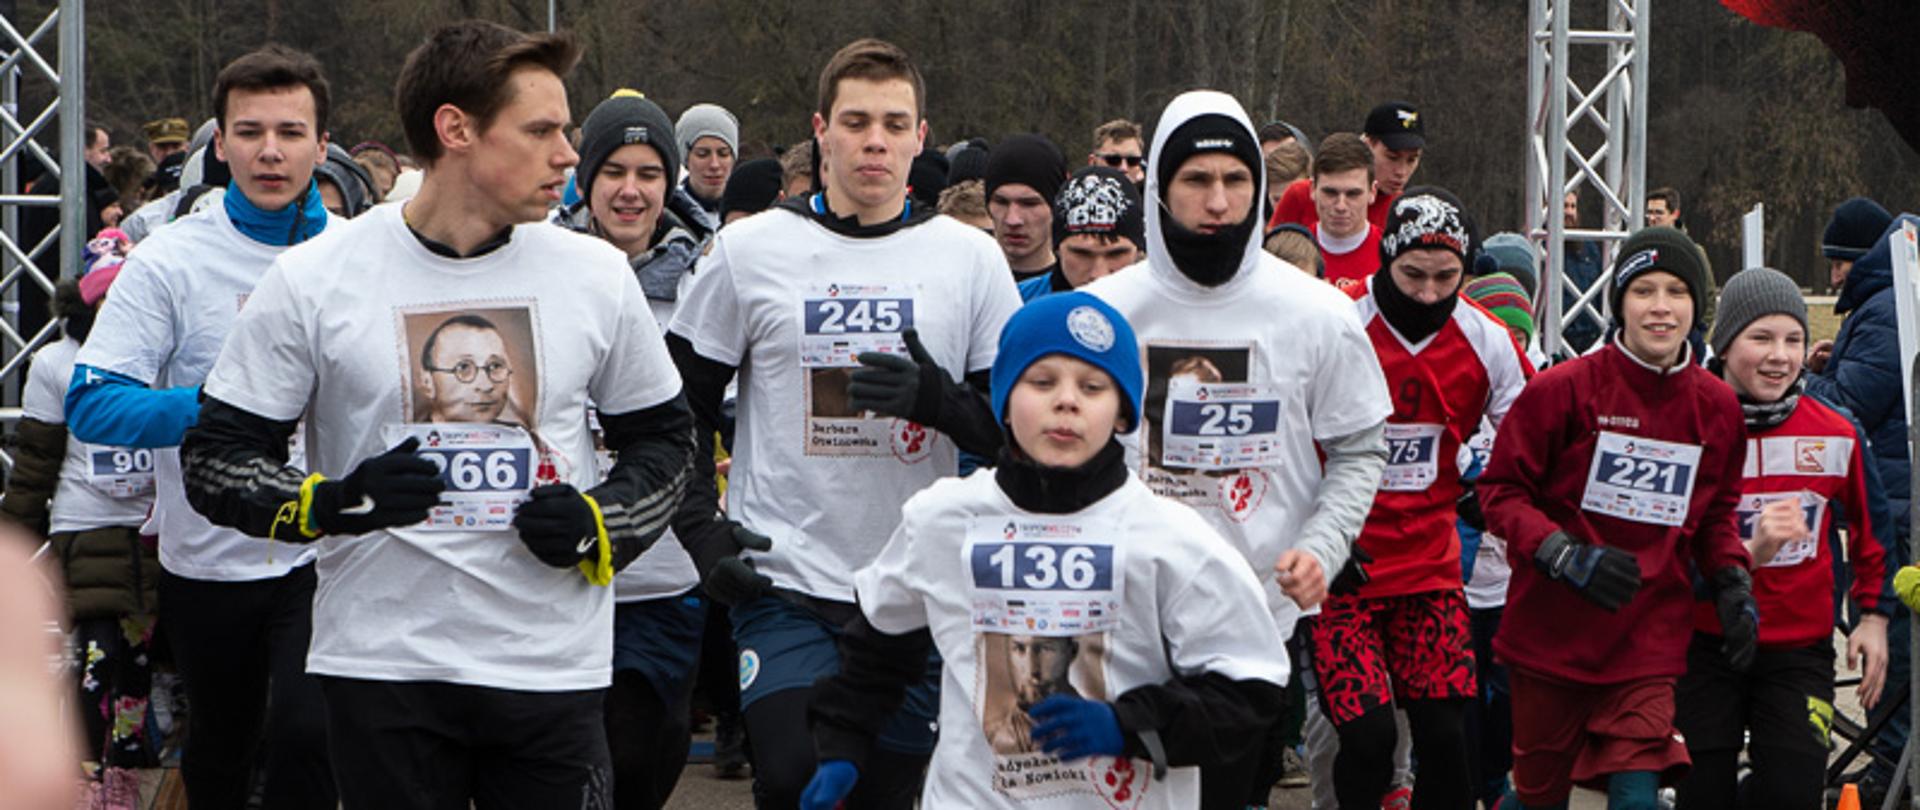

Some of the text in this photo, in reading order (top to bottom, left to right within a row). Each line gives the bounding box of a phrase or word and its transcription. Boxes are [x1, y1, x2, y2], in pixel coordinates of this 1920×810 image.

[818, 300, 902, 333] 245
[1199, 404, 1253, 436] 25
[112, 449, 153, 474] 90
[1386, 440, 1420, 464] 75
[1607, 457, 1678, 493] 221
[989, 544, 1097, 590] 136
